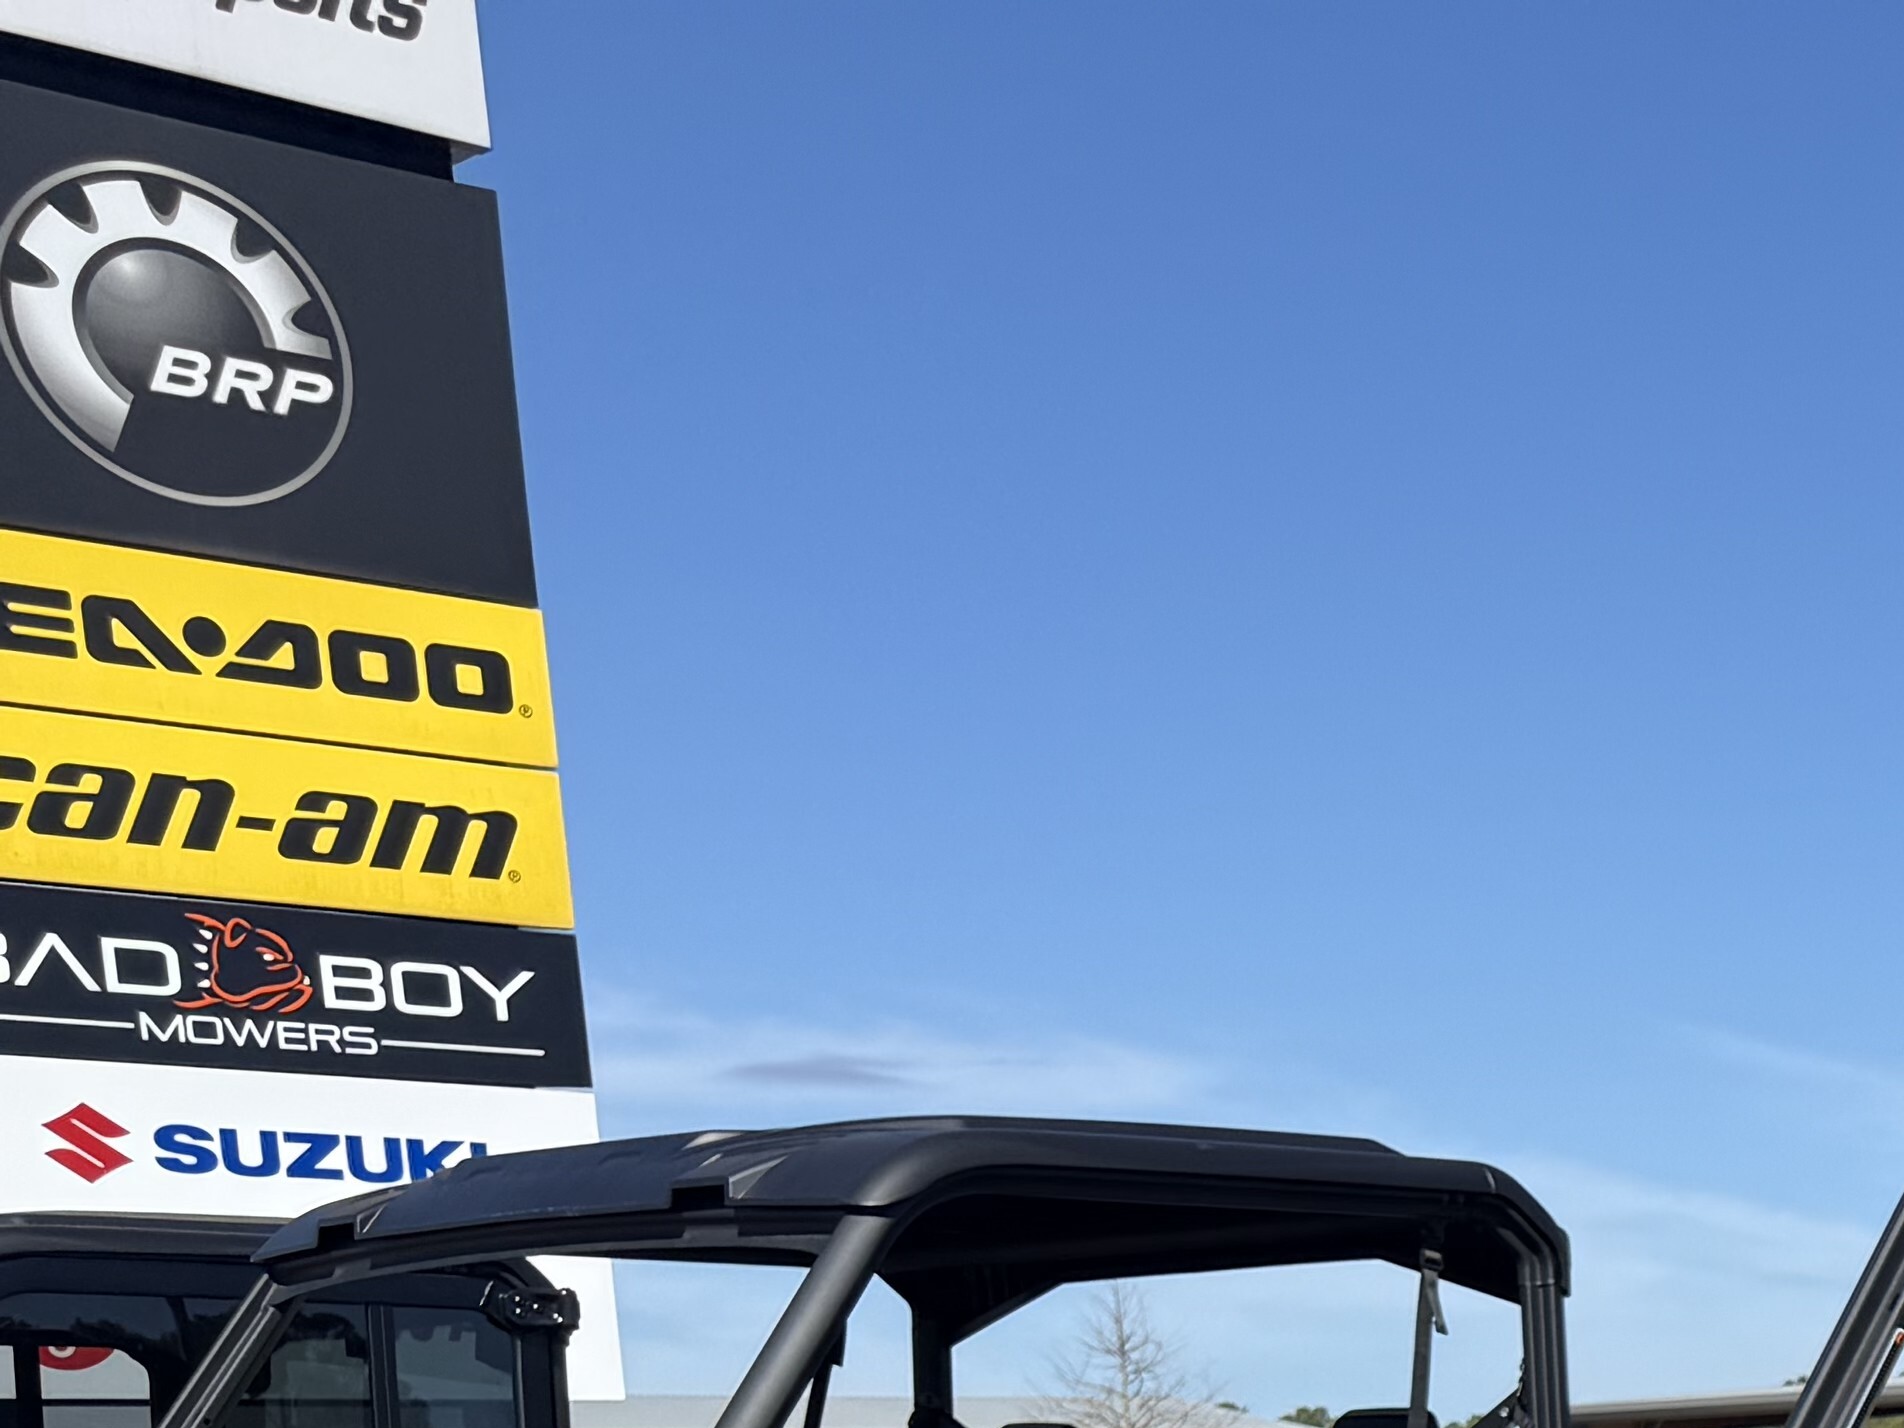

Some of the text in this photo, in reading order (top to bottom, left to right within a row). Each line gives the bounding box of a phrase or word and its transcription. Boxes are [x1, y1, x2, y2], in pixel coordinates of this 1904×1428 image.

[150, 345, 334, 416] BRP
[0, 932, 536, 1022] AD BOY
[139, 1011, 379, 1055] MOWERS
